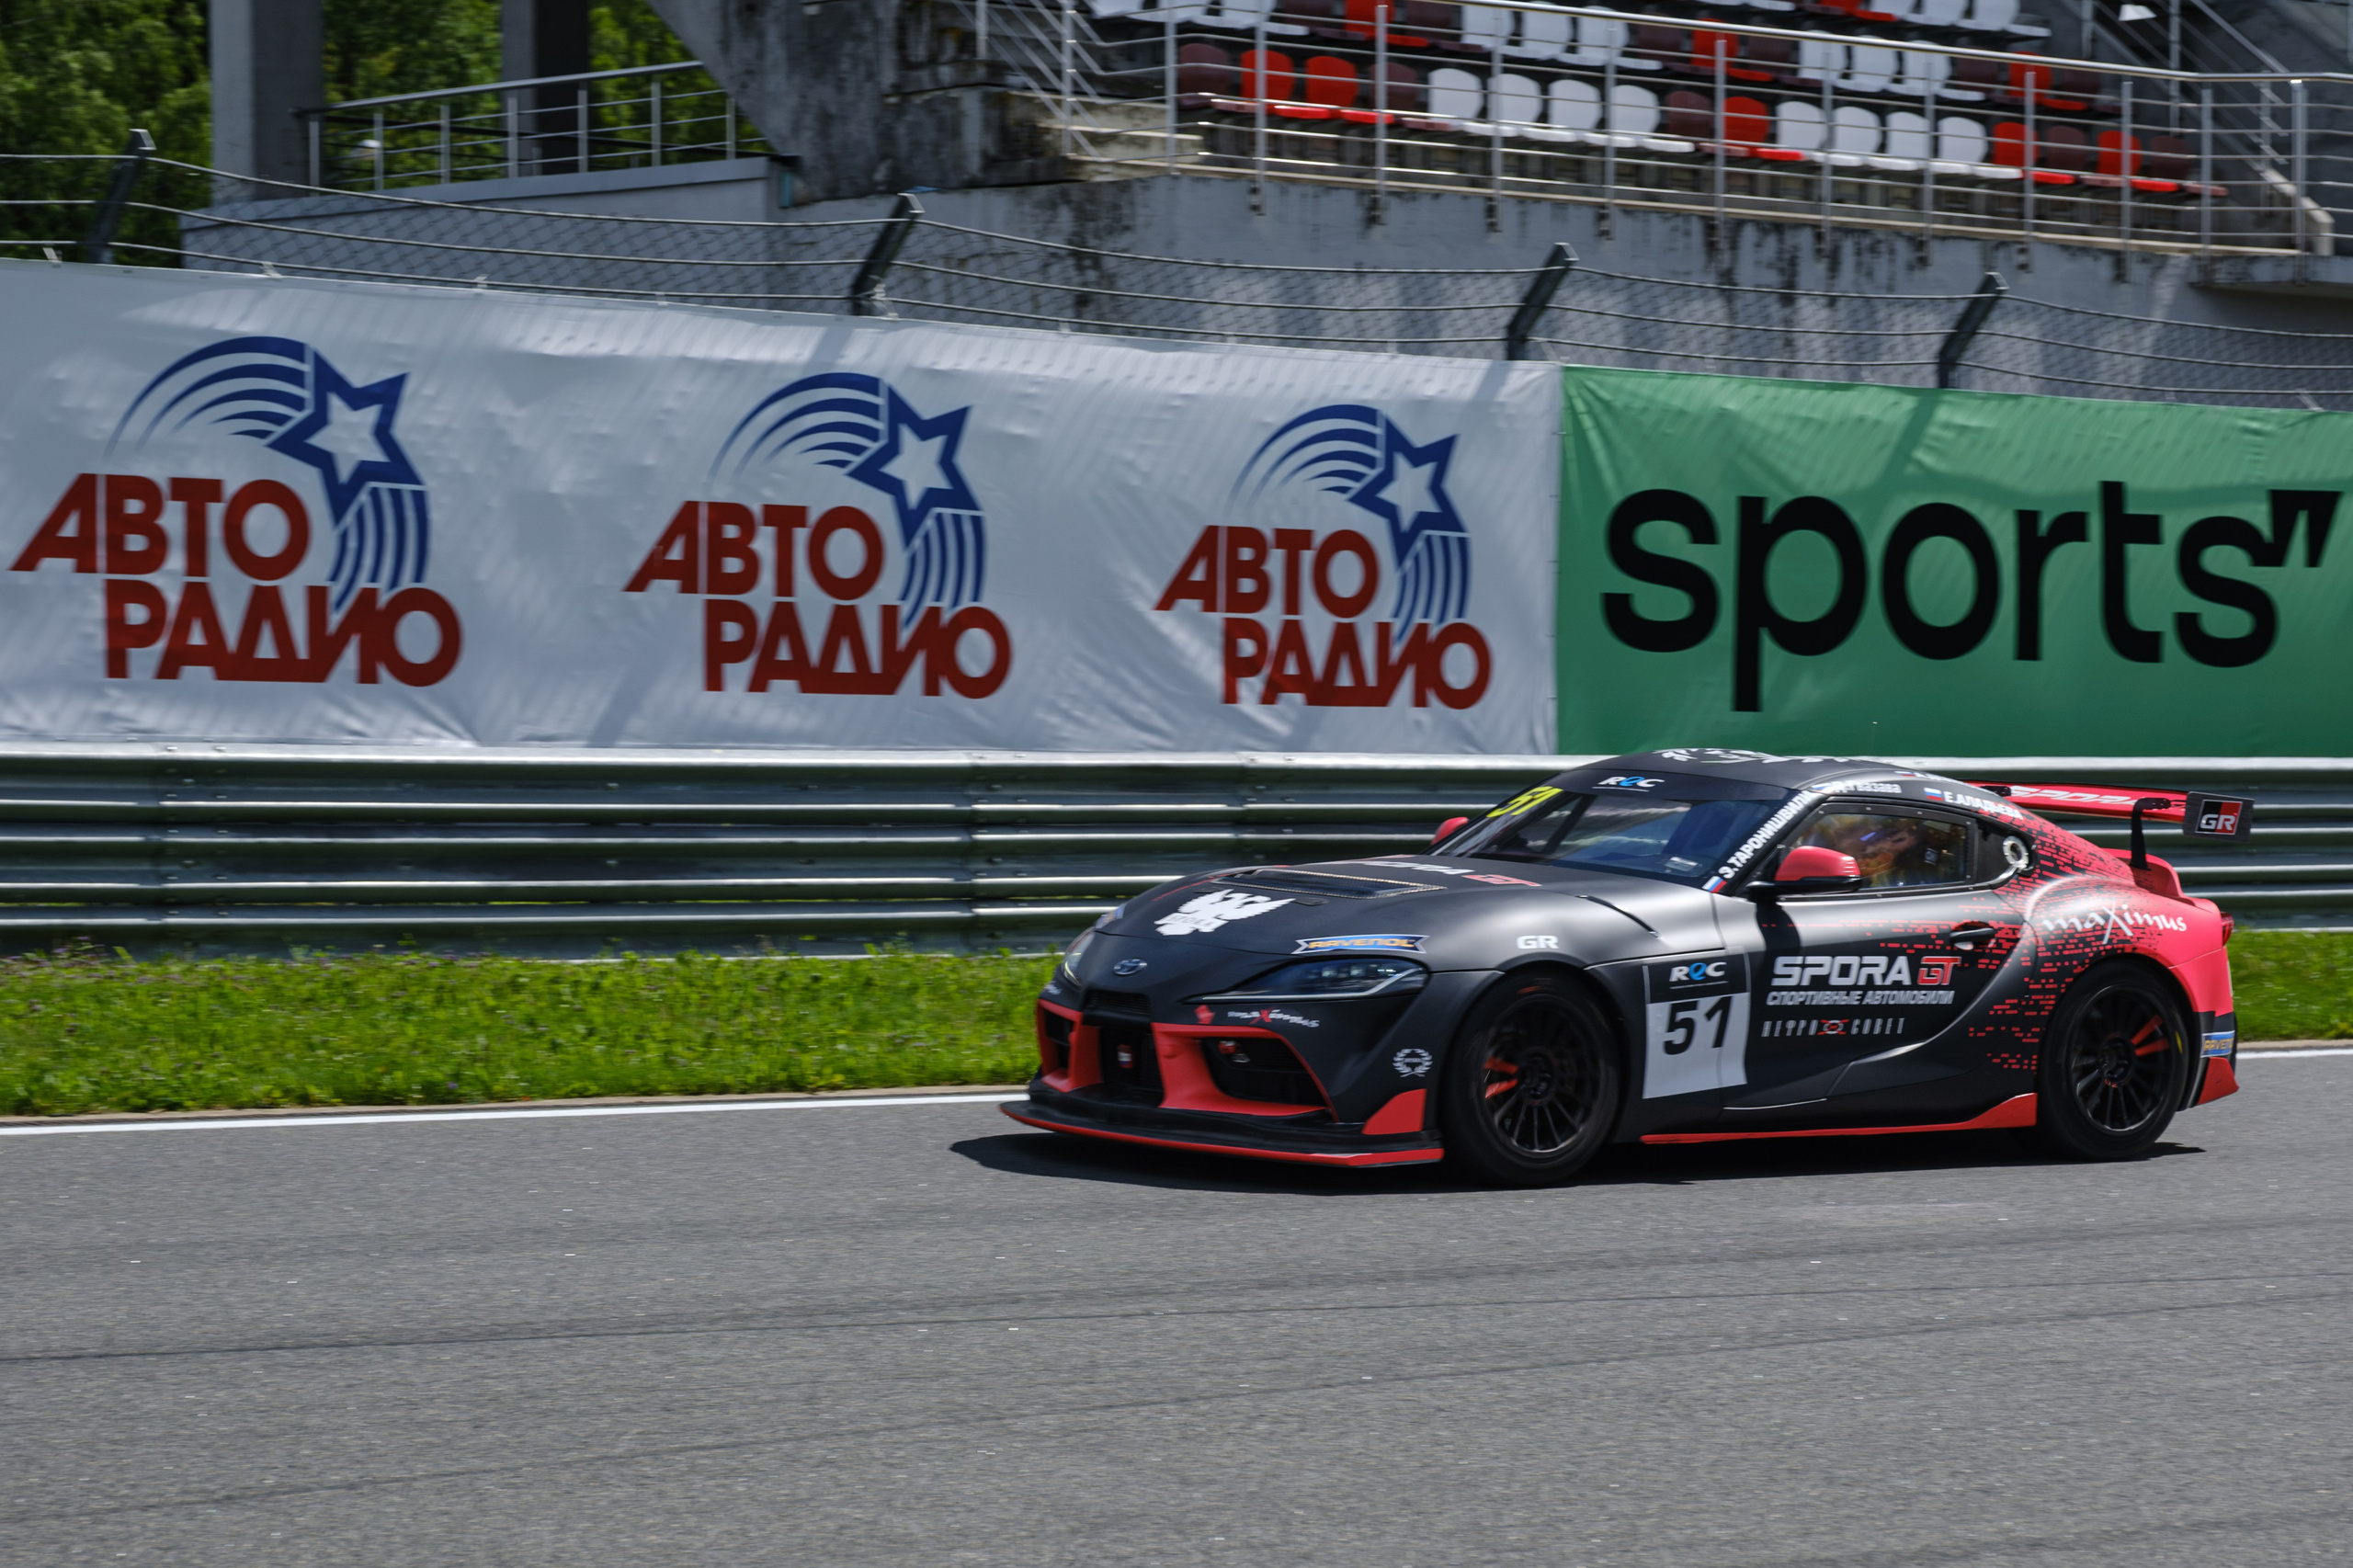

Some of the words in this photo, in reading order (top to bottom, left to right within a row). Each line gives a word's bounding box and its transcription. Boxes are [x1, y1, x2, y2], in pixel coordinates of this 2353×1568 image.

[9, 472, 311, 581] АВТО
[623, 500, 885, 601] АВТО
[1154, 525, 1381, 619] АВТО
[103, 578, 463, 687] РАДИО
[702, 598, 1012, 699] РАДИО
[1221, 617, 1494, 710] РАДИО
[1486, 786, 1563, 817] 51
[2010, 785, 2138, 805] SPOR
[2200, 813, 2236, 831] GR
[1516, 935, 1560, 949] GR
[1770, 956, 1913, 986] SPORA
[1917, 956, 1962, 985] GT
[1663, 995, 1734, 1055] 51
[1766, 991, 1862, 1006] СПОРТИВНЫЕ
[1861, 990, 1956, 1006] АВТОМОБИЛИ
